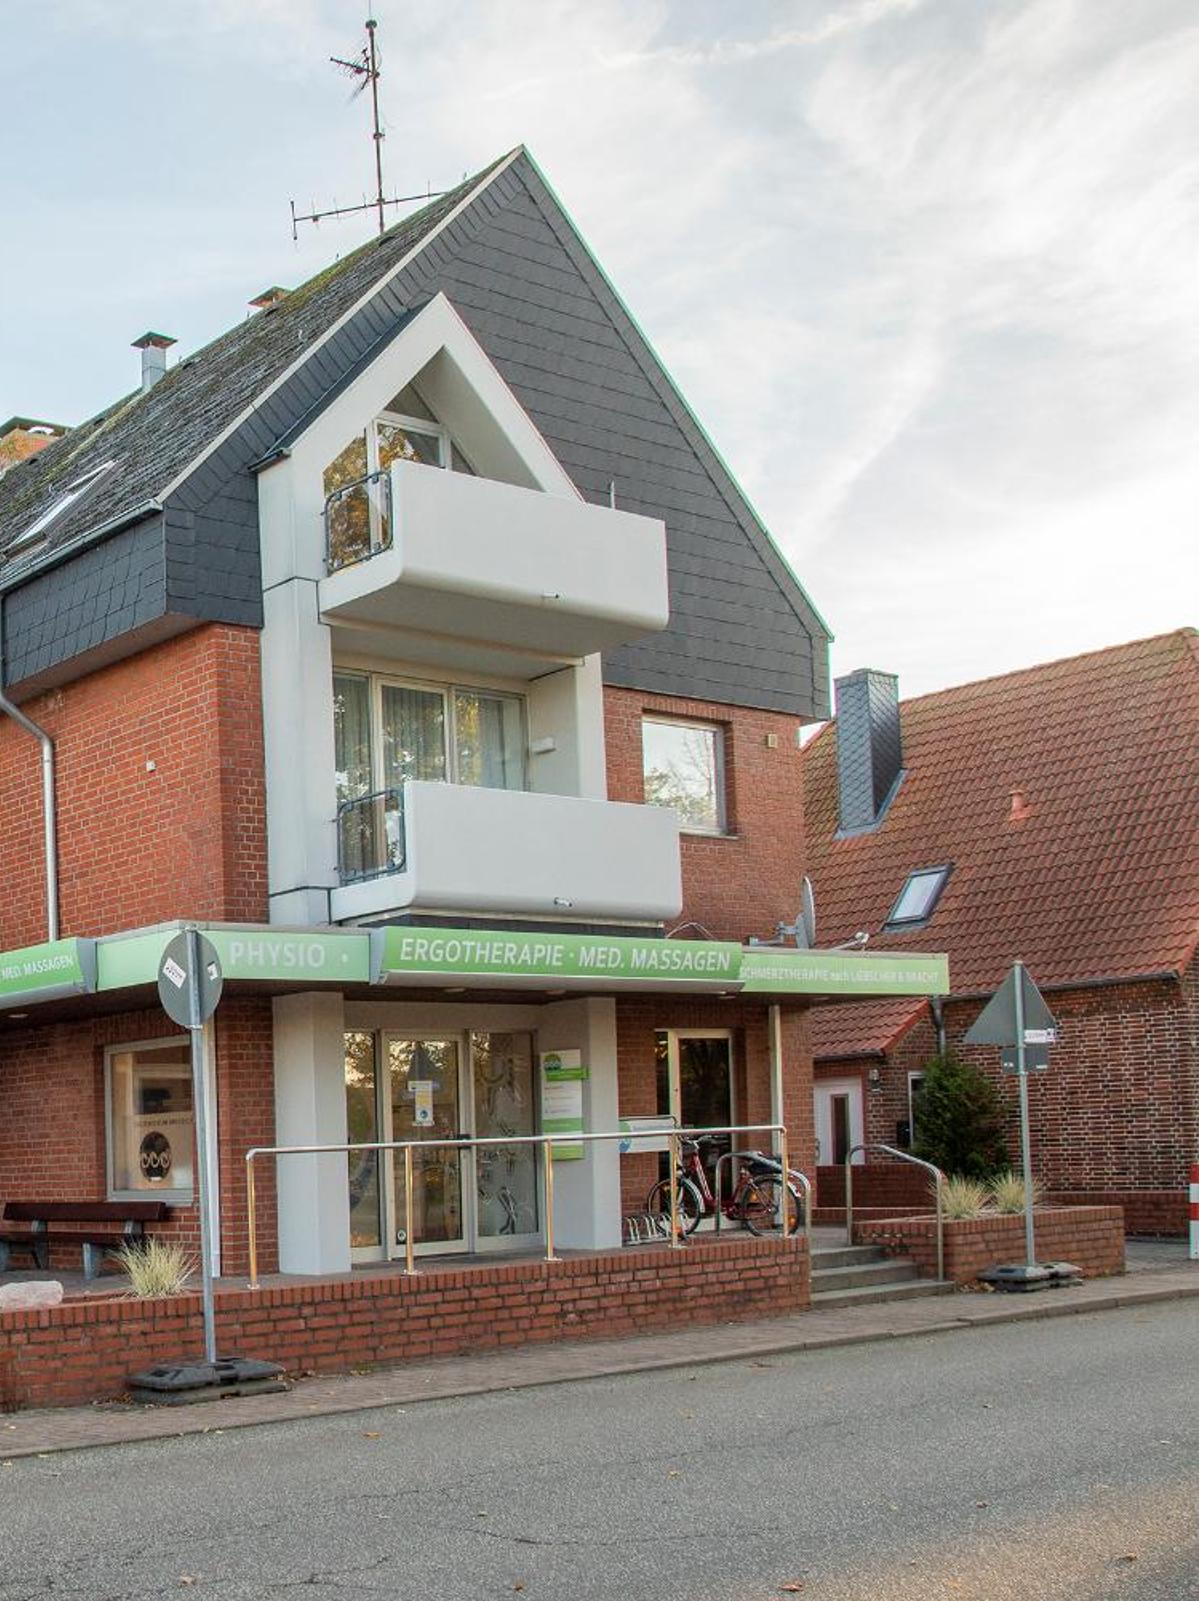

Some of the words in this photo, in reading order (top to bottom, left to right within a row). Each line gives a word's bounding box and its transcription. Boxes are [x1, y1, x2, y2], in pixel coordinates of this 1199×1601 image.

[23, 954, 74, 975] MASSAGEN
[229, 941, 326, 968] PHYSIO
[399, 938, 564, 967] ERGOTHERAPIE
[578, 946, 625, 969] MED.
[630, 948, 731, 972] MASSAGEN
